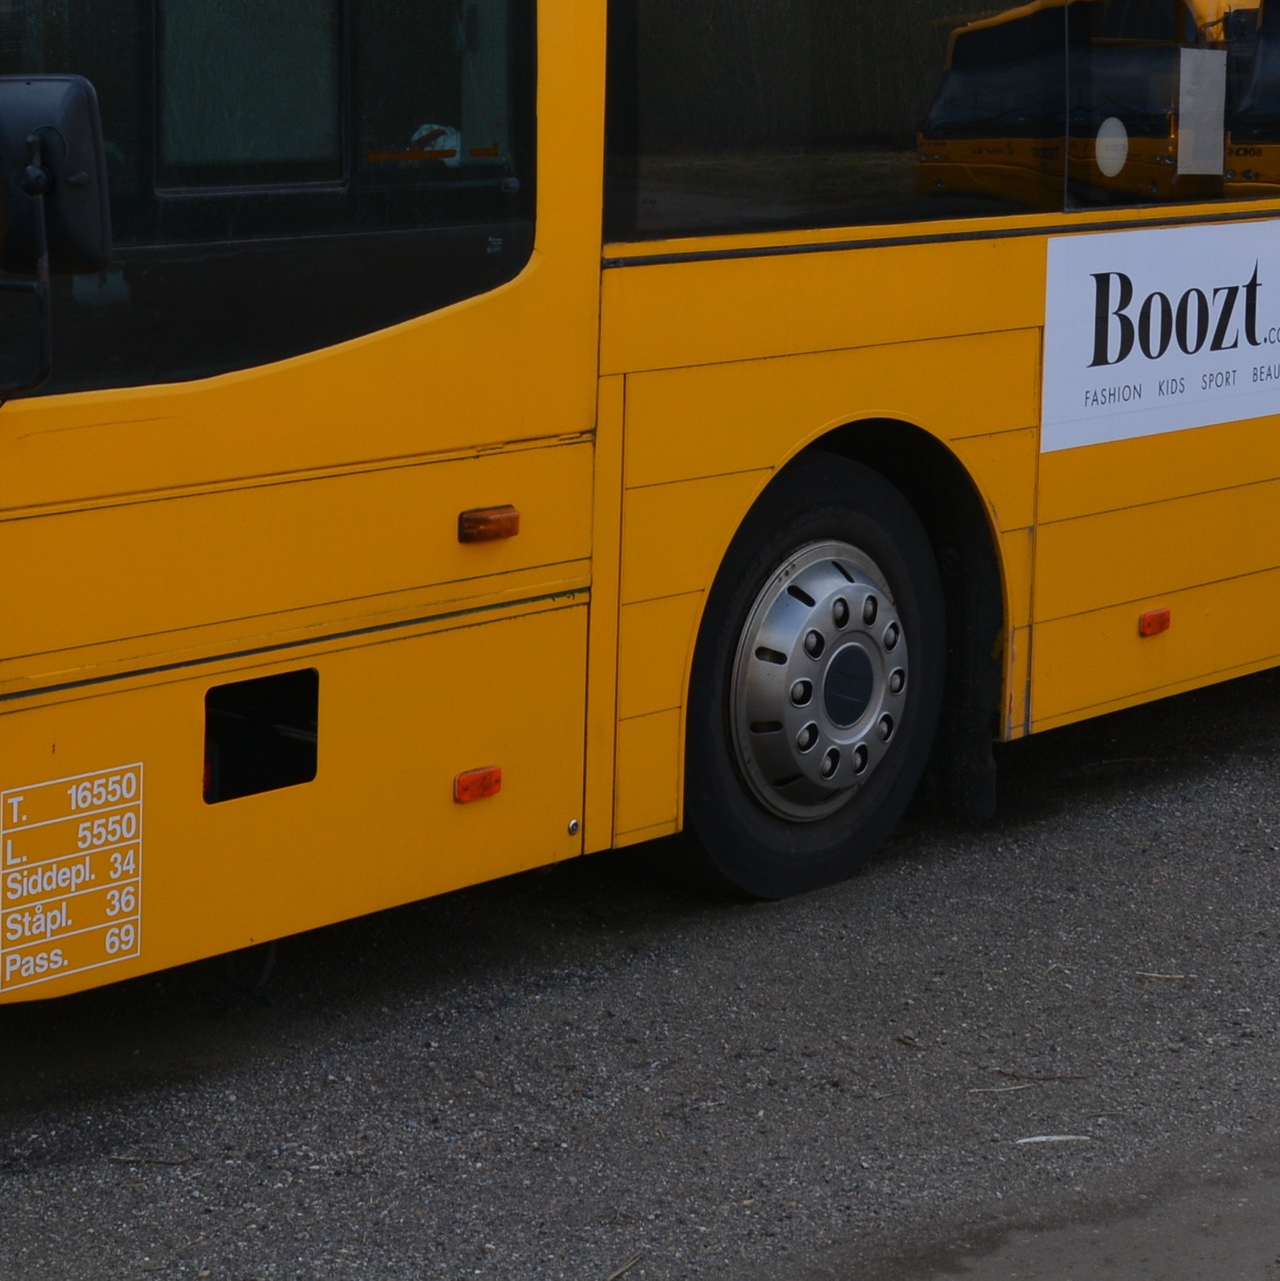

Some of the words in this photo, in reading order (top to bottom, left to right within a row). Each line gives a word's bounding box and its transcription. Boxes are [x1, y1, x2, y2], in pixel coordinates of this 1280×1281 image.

[1084, 383, 1142, 407] FASHION
[1158, 377, 1186, 397] KIDS
[1201, 370, 1238, 390] SPORT
[7, 796, 27, 823] T.
[67, 772, 137, 810] 16550
[6, 839, 28, 865] L.
[77, 812, 137, 849] 5550
[6, 855, 96, 900] Siddepl.
[109, 849, 136, 879] 34
[6, 902, 73, 941] Ståpl.
[105, 886, 136, 917] 36
[5, 948, 69, 981] Pass.
[105, 924, 135, 954] 69
